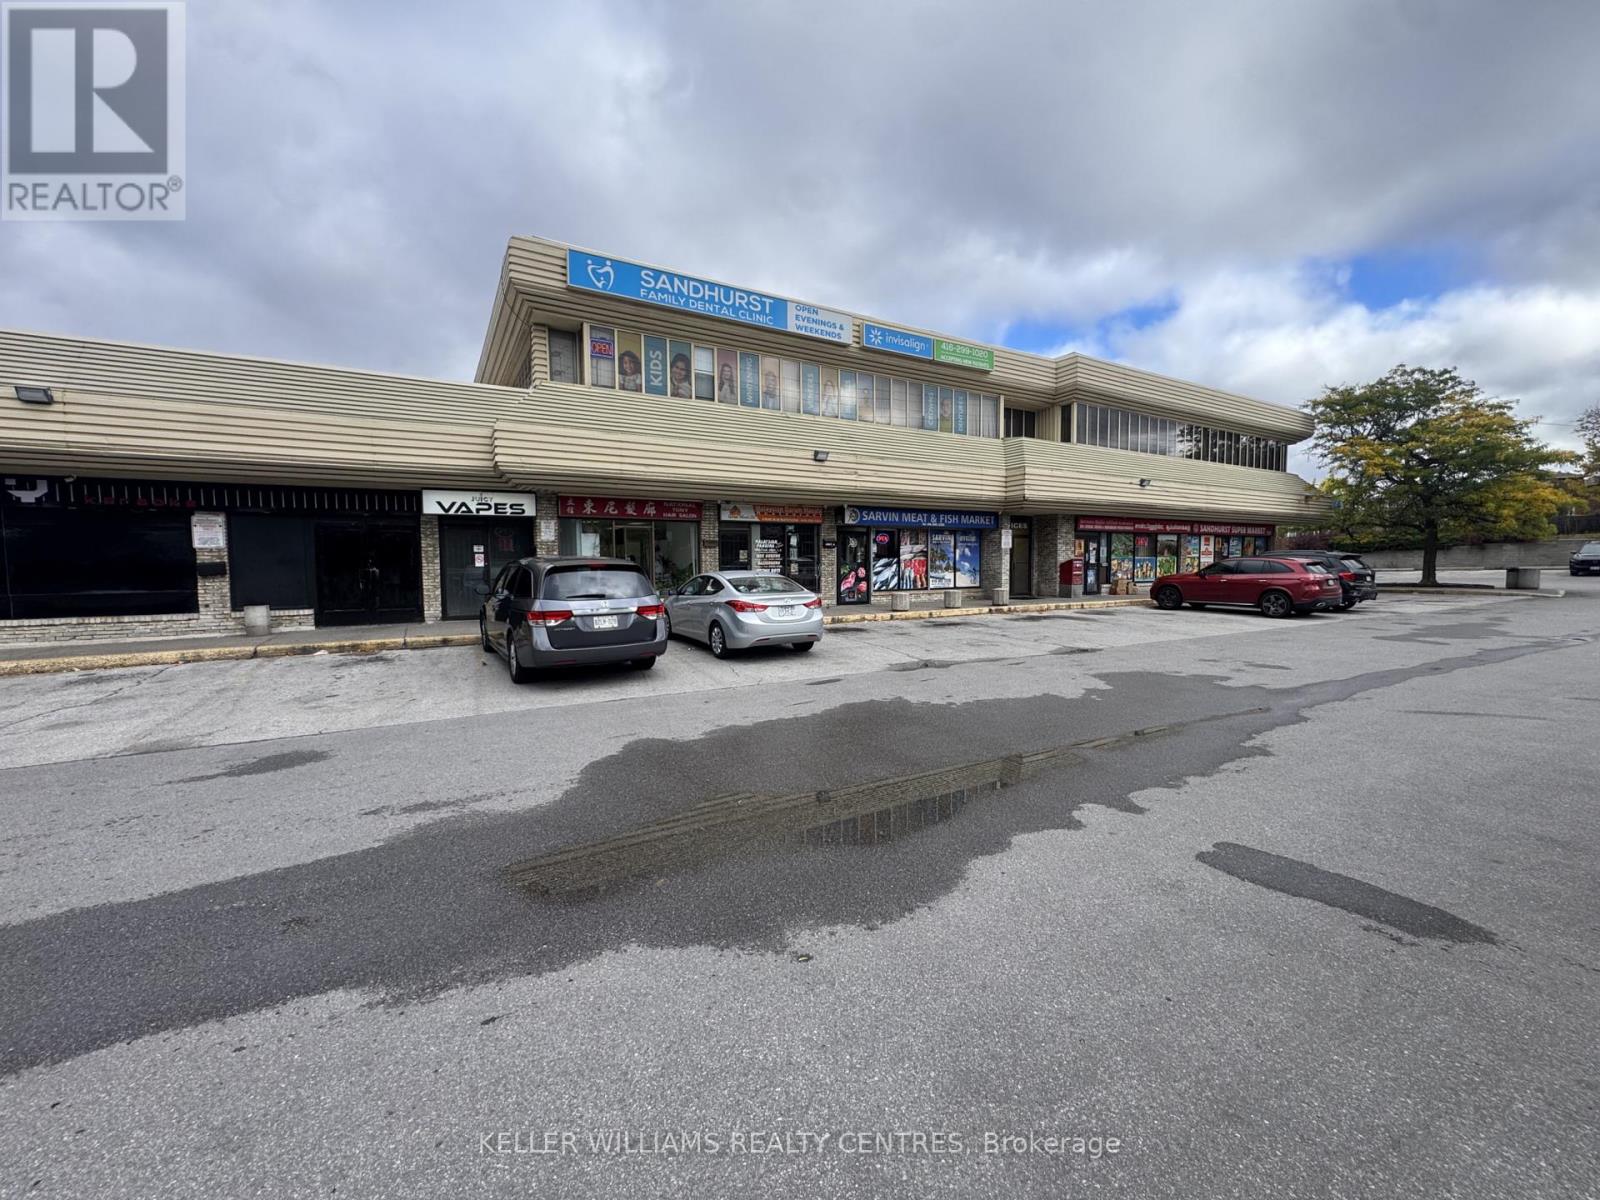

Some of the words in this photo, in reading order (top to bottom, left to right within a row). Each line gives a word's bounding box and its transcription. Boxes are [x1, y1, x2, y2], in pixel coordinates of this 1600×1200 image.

[640, 270, 773, 314] SANDHURST
[640, 288, 686, 306] FAMILY
[689, 300, 736, 317] DENTAL
[739, 310, 774, 325] CLINIC
[795, 304, 818, 316] OPEN
[795, 314, 837, 330] EVENINGS
[795, 323, 842, 340] WEEKENDS
[592, 342, 612, 356] OPEN
[885, 333, 926, 352] invisalign
[651, 350, 662, 386] KIDS
[436, 501, 526, 515] VAPES
[862, 510, 899, 522] SARVIN
[902, 512, 928, 523] MEAT
[930, 514, 938, 523] &
[940, 514, 959, 525] FISH
[961, 515, 995, 526] MARKET
